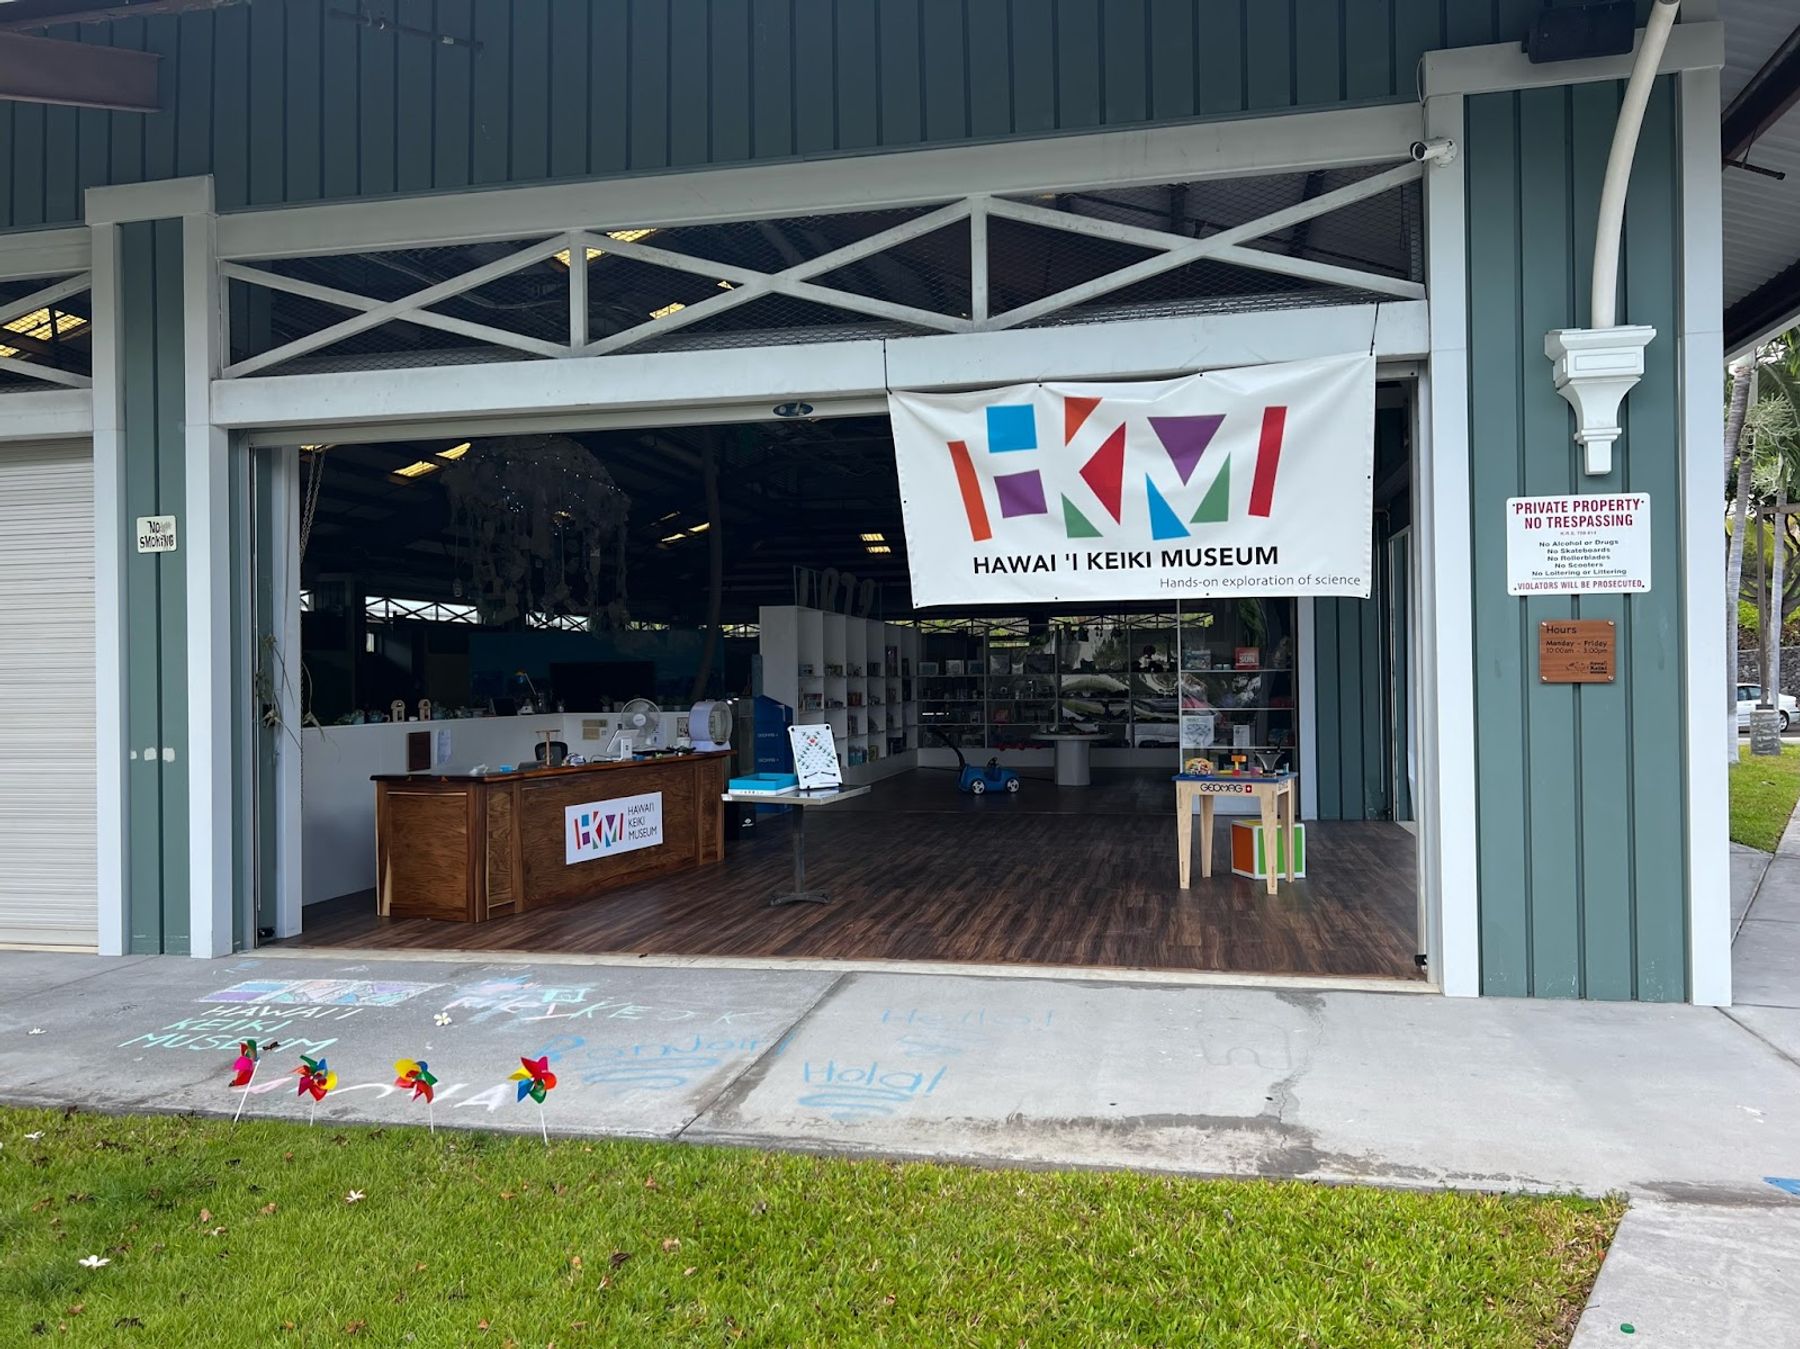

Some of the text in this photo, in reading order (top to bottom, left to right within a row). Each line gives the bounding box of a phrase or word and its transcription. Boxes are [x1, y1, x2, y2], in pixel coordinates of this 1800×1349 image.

[1516, 498, 1640, 514] PRIVATE PROPERTY
[147, 521, 160, 533] NO
[1525, 514, 1633, 529] NO TRESPASSING
[140, 534, 174, 548] SMOKING
[1087, 551, 1152, 571] KEIKI
[1161, 546, 1279, 569] MUSEUM
[1160, 573, 1361, 590] Hands-on exploration of science
[1517, 581, 1558, 590] VIOLATORS
[1561, 581, 1578, 589] WILL
[1593, 579, 1642, 589] PROSECUTED
[1546, 625, 1577, 634] Hours
[1200, 783, 1243, 793] GEOMAG
[628, 816, 646, 829] KEIKI
[628, 826, 658, 841] MUSEUM
[163, 1018, 293, 1033] KEIKI
[803, 1060, 948, 1096] Hola!
